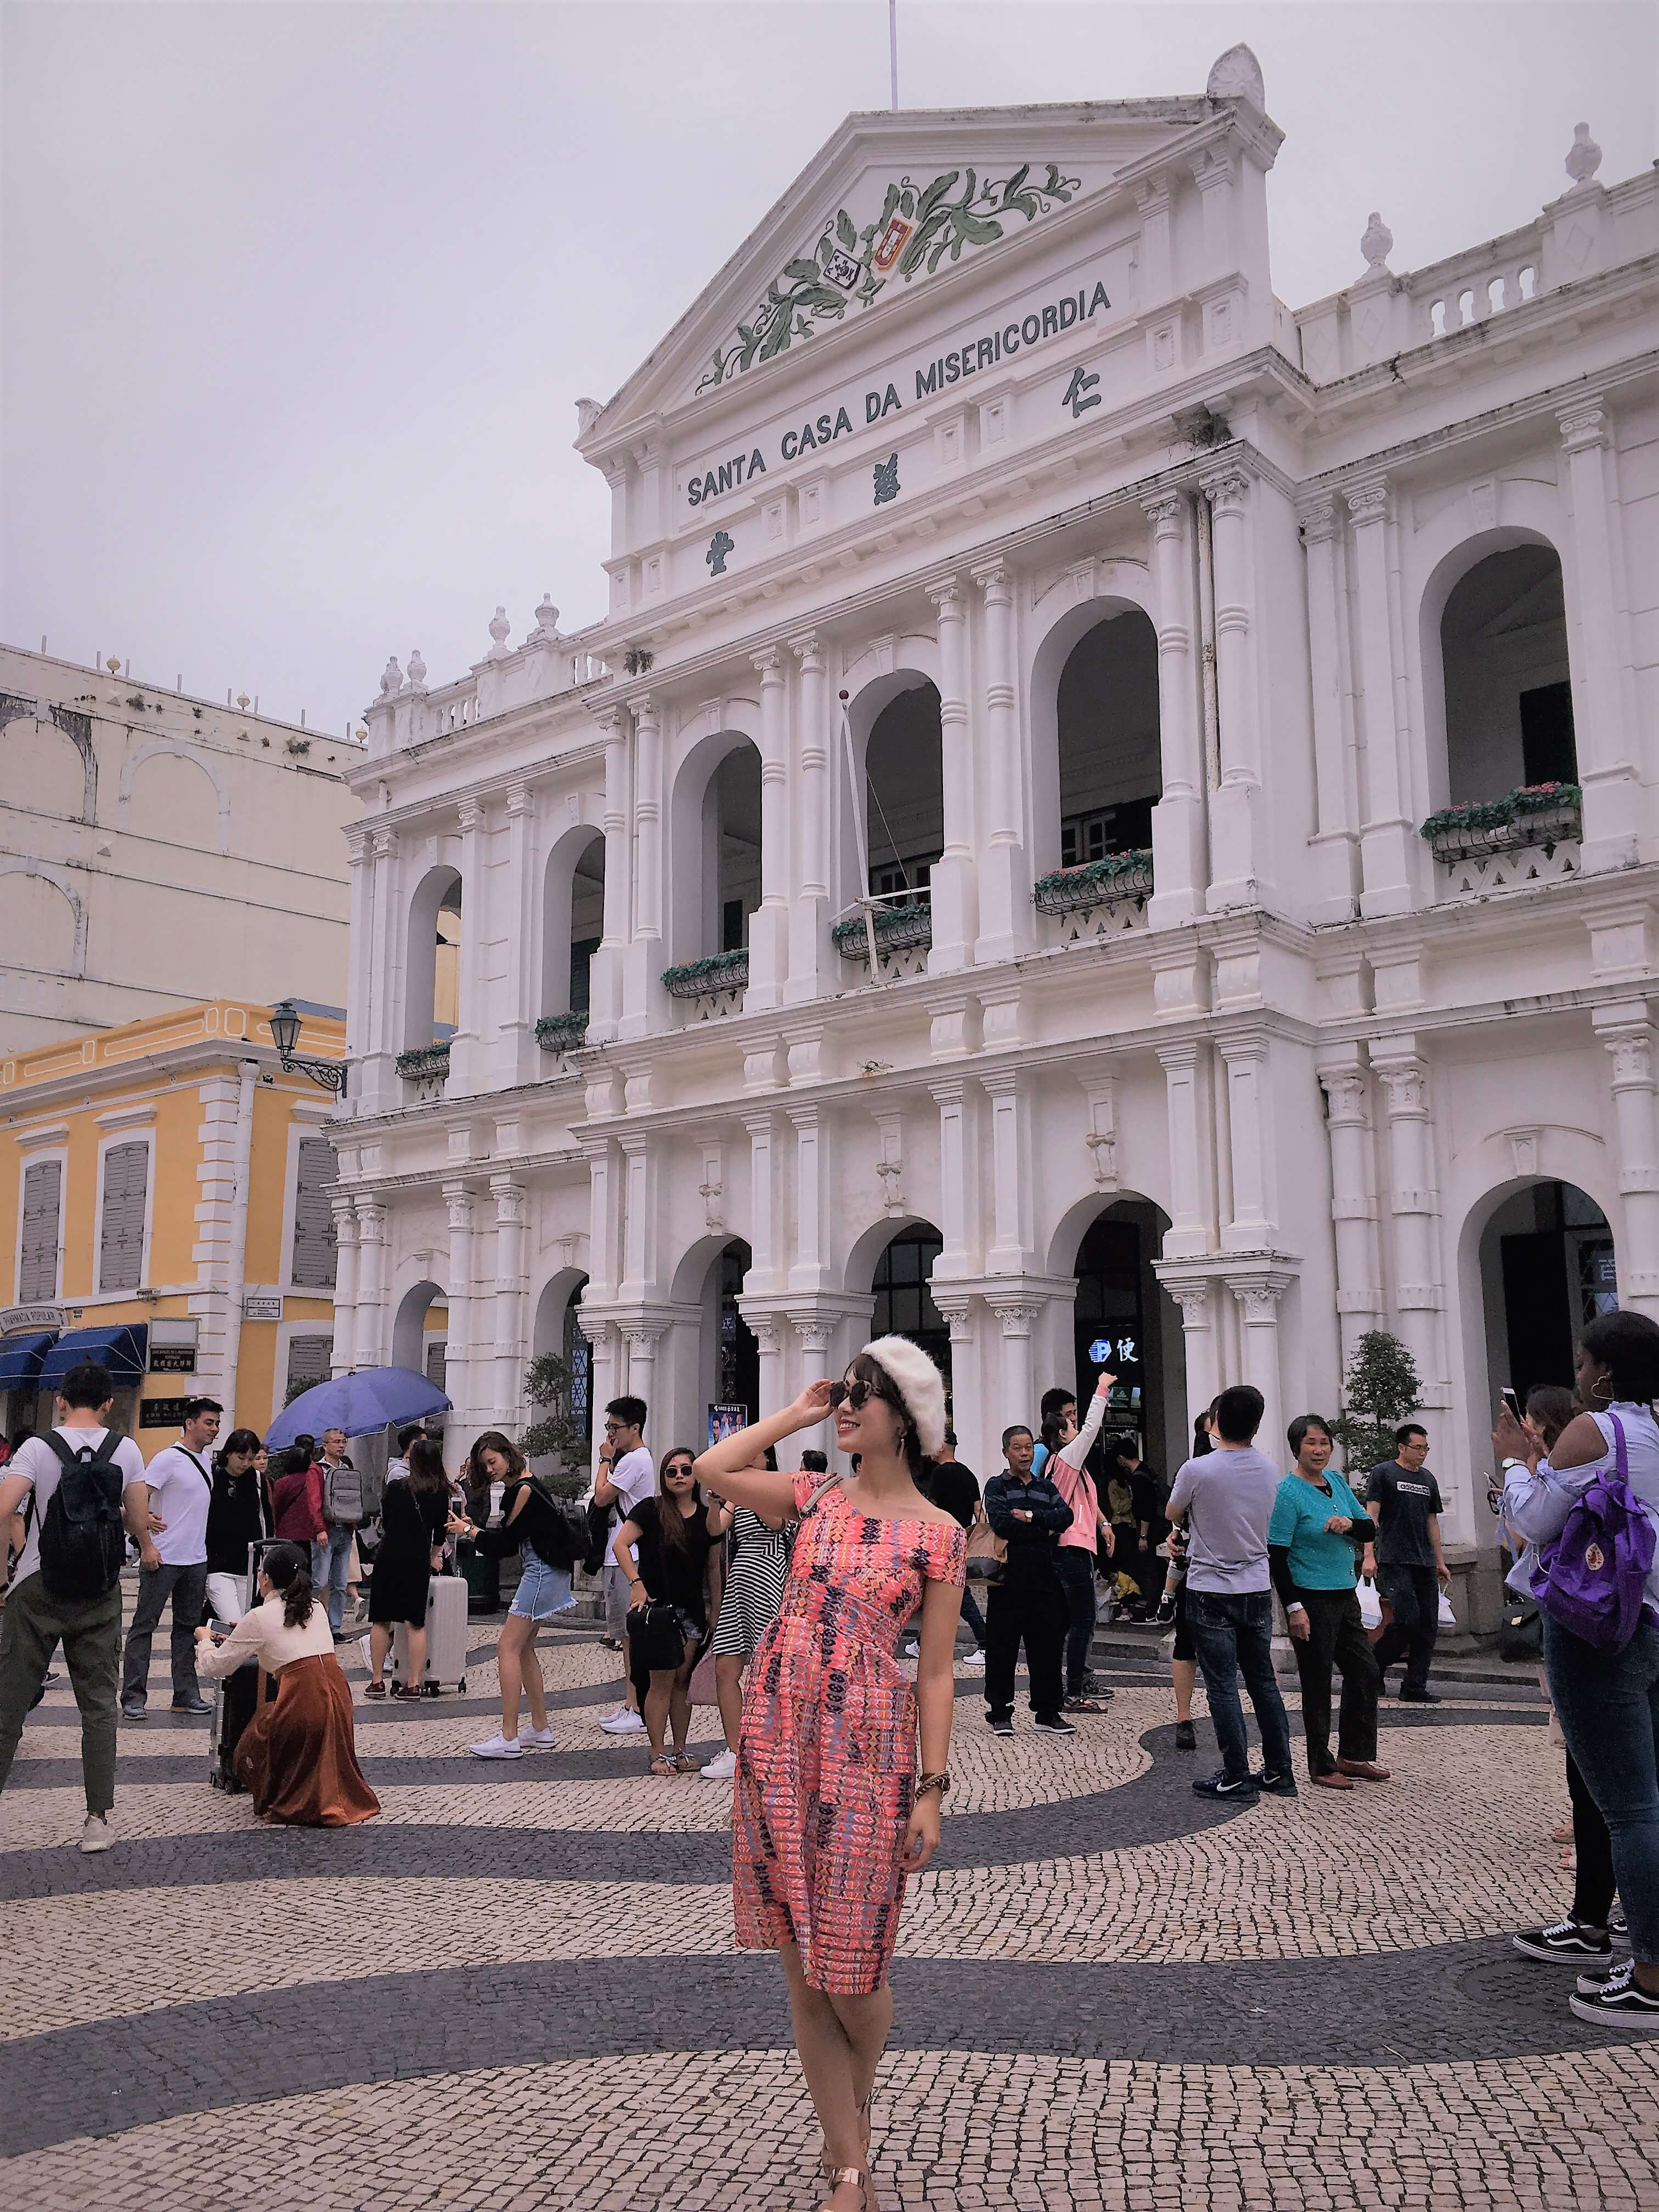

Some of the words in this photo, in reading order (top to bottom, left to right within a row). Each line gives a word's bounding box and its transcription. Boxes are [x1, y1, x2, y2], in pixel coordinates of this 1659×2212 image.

[689, 449, 766, 506] SANTA
[782, 407, 854, 460] CASA
[866, 383, 902, 424] DA
[916, 281, 1111, 399] MISERICORDIA
[1062, 366, 1102, 419] 仁
[1117, 1337, 1139, 1362] 便
[1401, 1484, 1423, 1493] adidas
